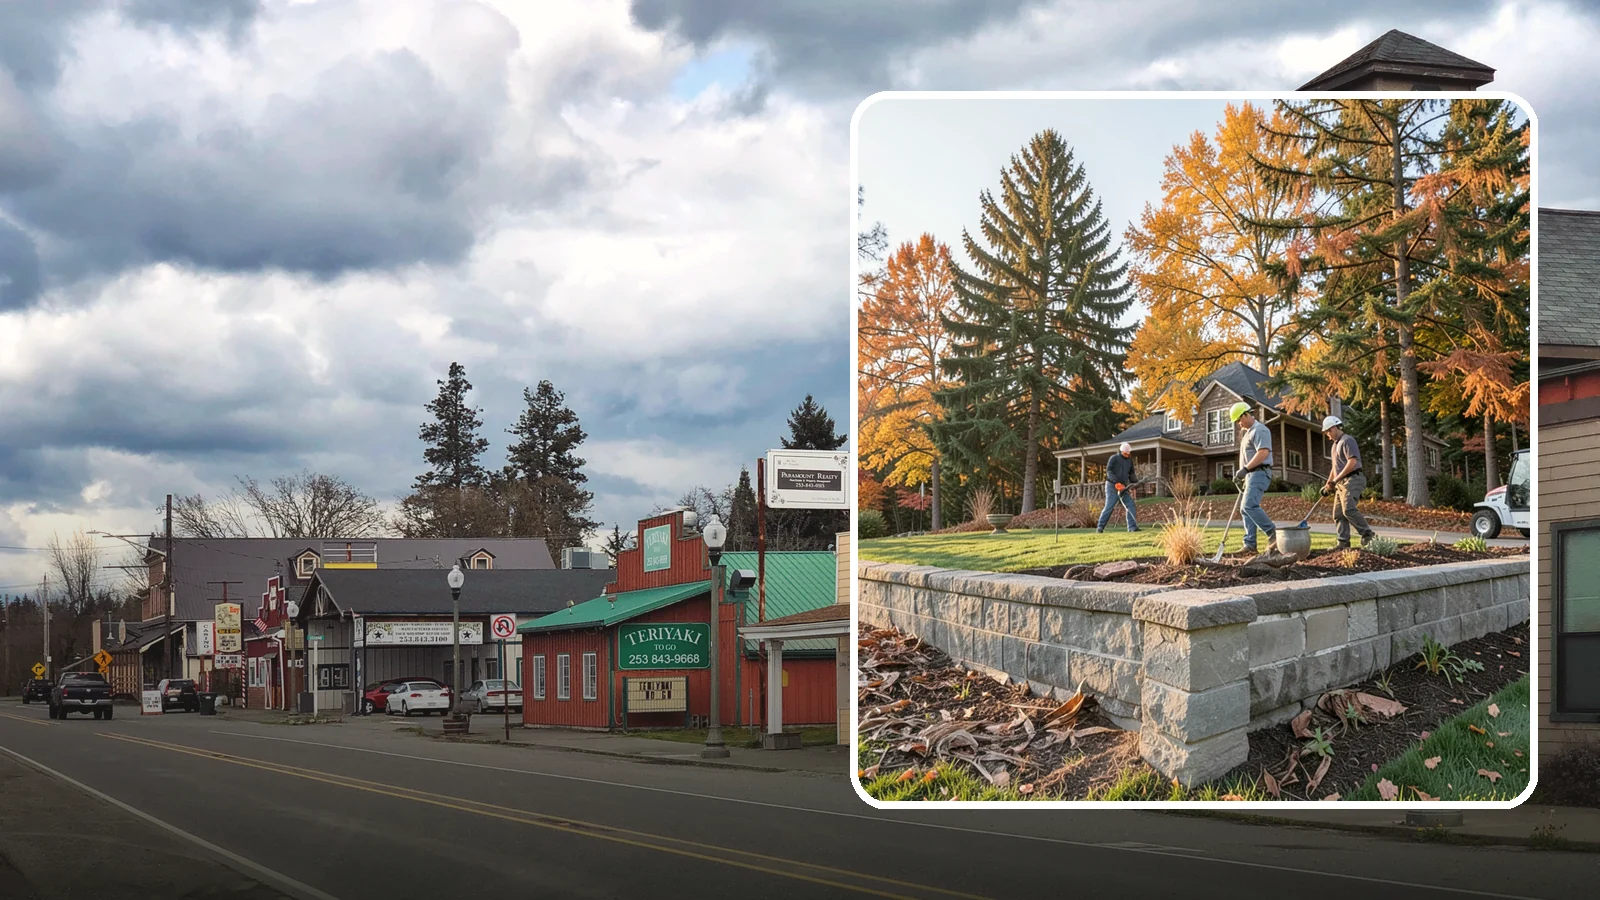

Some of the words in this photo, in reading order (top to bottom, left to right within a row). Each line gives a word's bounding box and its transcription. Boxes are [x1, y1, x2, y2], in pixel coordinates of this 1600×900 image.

[624, 628, 702, 646] TERIYAKI
[629, 654, 648, 664] 253
[651, 654, 700, 664] 843-9668
